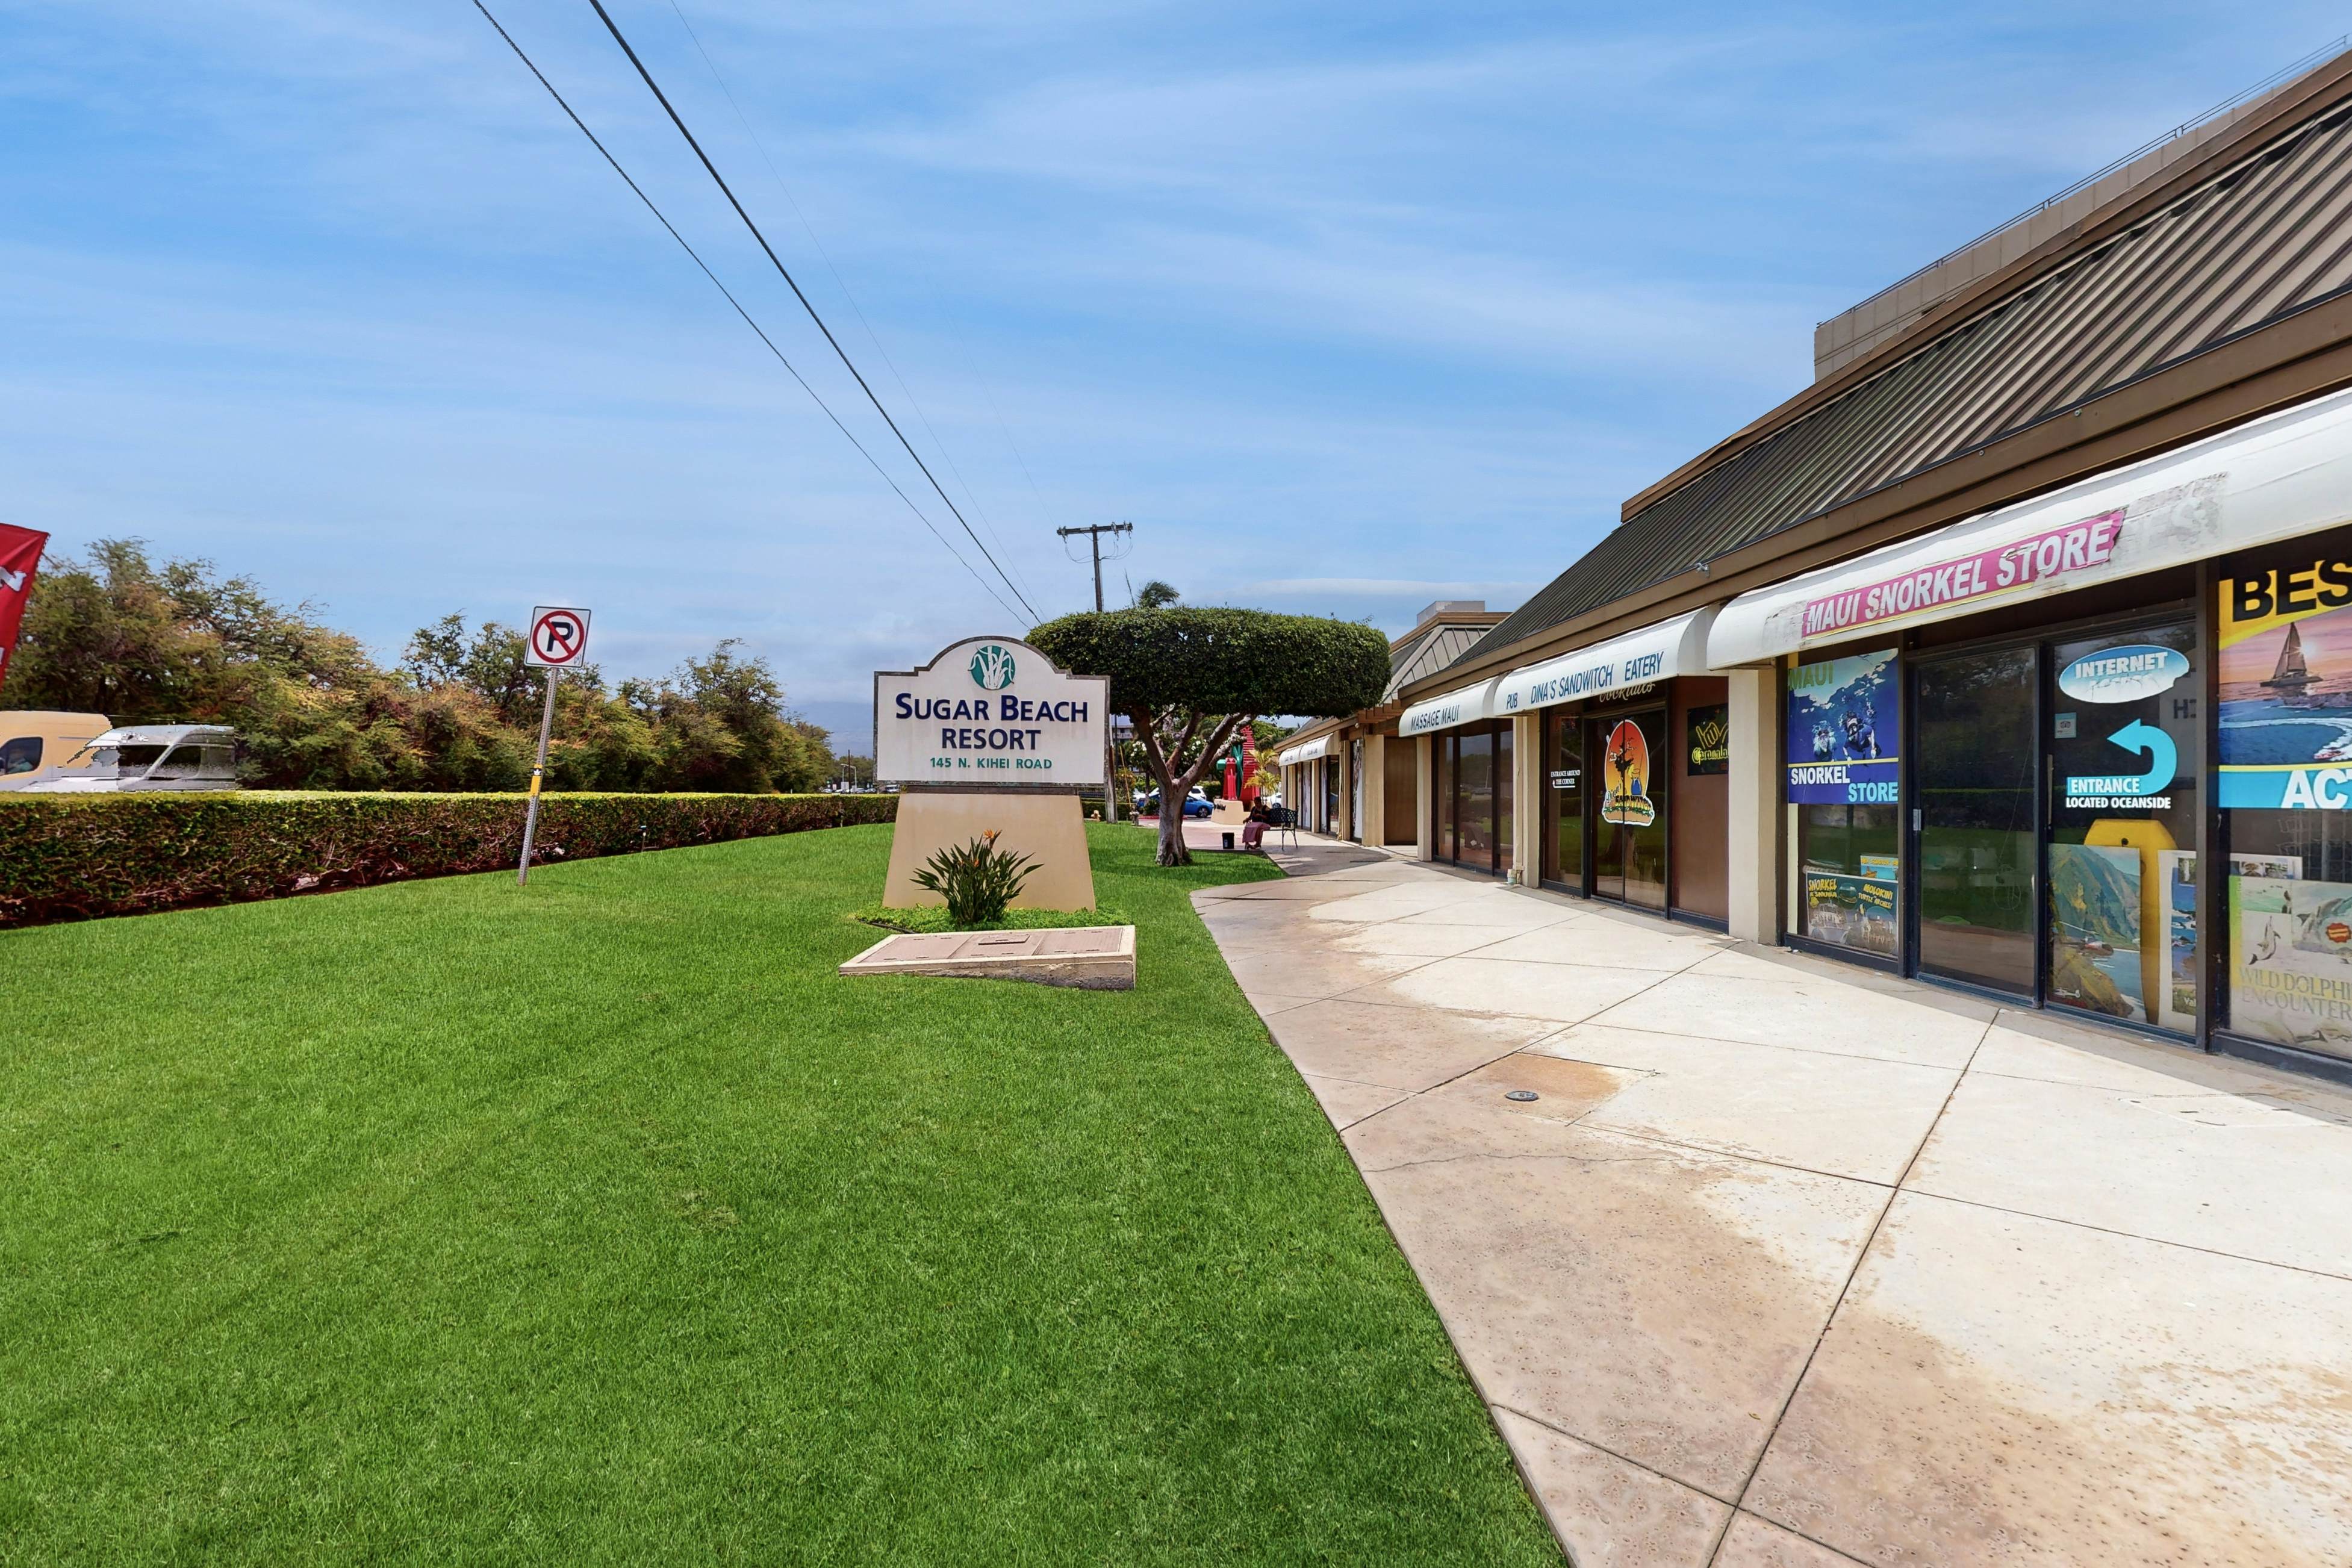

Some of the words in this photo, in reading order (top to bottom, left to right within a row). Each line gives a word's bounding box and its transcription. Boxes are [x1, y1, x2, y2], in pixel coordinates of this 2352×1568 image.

[1807, 593, 1861, 633] MAUI
[1865, 558, 1987, 620] SNORKEL
[1996, 519, 2114, 587] STORE
[2232, 559, 2352, 623] BES
[546, 621, 574, 652] P
[1788, 662, 1834, 691] MAUI
[2076, 652, 2168, 679] INTERNET
[1506, 692, 1518, 711] PUB
[1531, 679, 1557, 705] DINA'S
[1558, 663, 1614, 698] SANDWITCH
[1625, 651, 1664, 682] EATERY
[895, 692, 990, 721] SUGAR
[1000, 694, 1088, 723] BEACH
[1410, 709, 1441, 732] MASSAGE
[1441, 704, 1460, 724] MAUI
[941, 727, 1042, 750] RESORT
[930, 757, 952, 768] 145
[958, 758, 971, 768] N.
[977, 758, 1010, 769] KIHEI
[1016, 758, 1053, 769] ROAD
[1791, 765, 1850, 785] SNORKEL
[1848, 782, 1899, 802] STORE
[2071, 777, 2140, 794] ENTRANCE
[2280, 768, 2352, 809] AC
[2066, 797, 2108, 808] LOCATED
[2111, 797, 2171, 809] OCEANSIDE
[1808, 878, 1837, 892] SNORKEL
[1863, 883, 1894, 901] MOLOKINI
